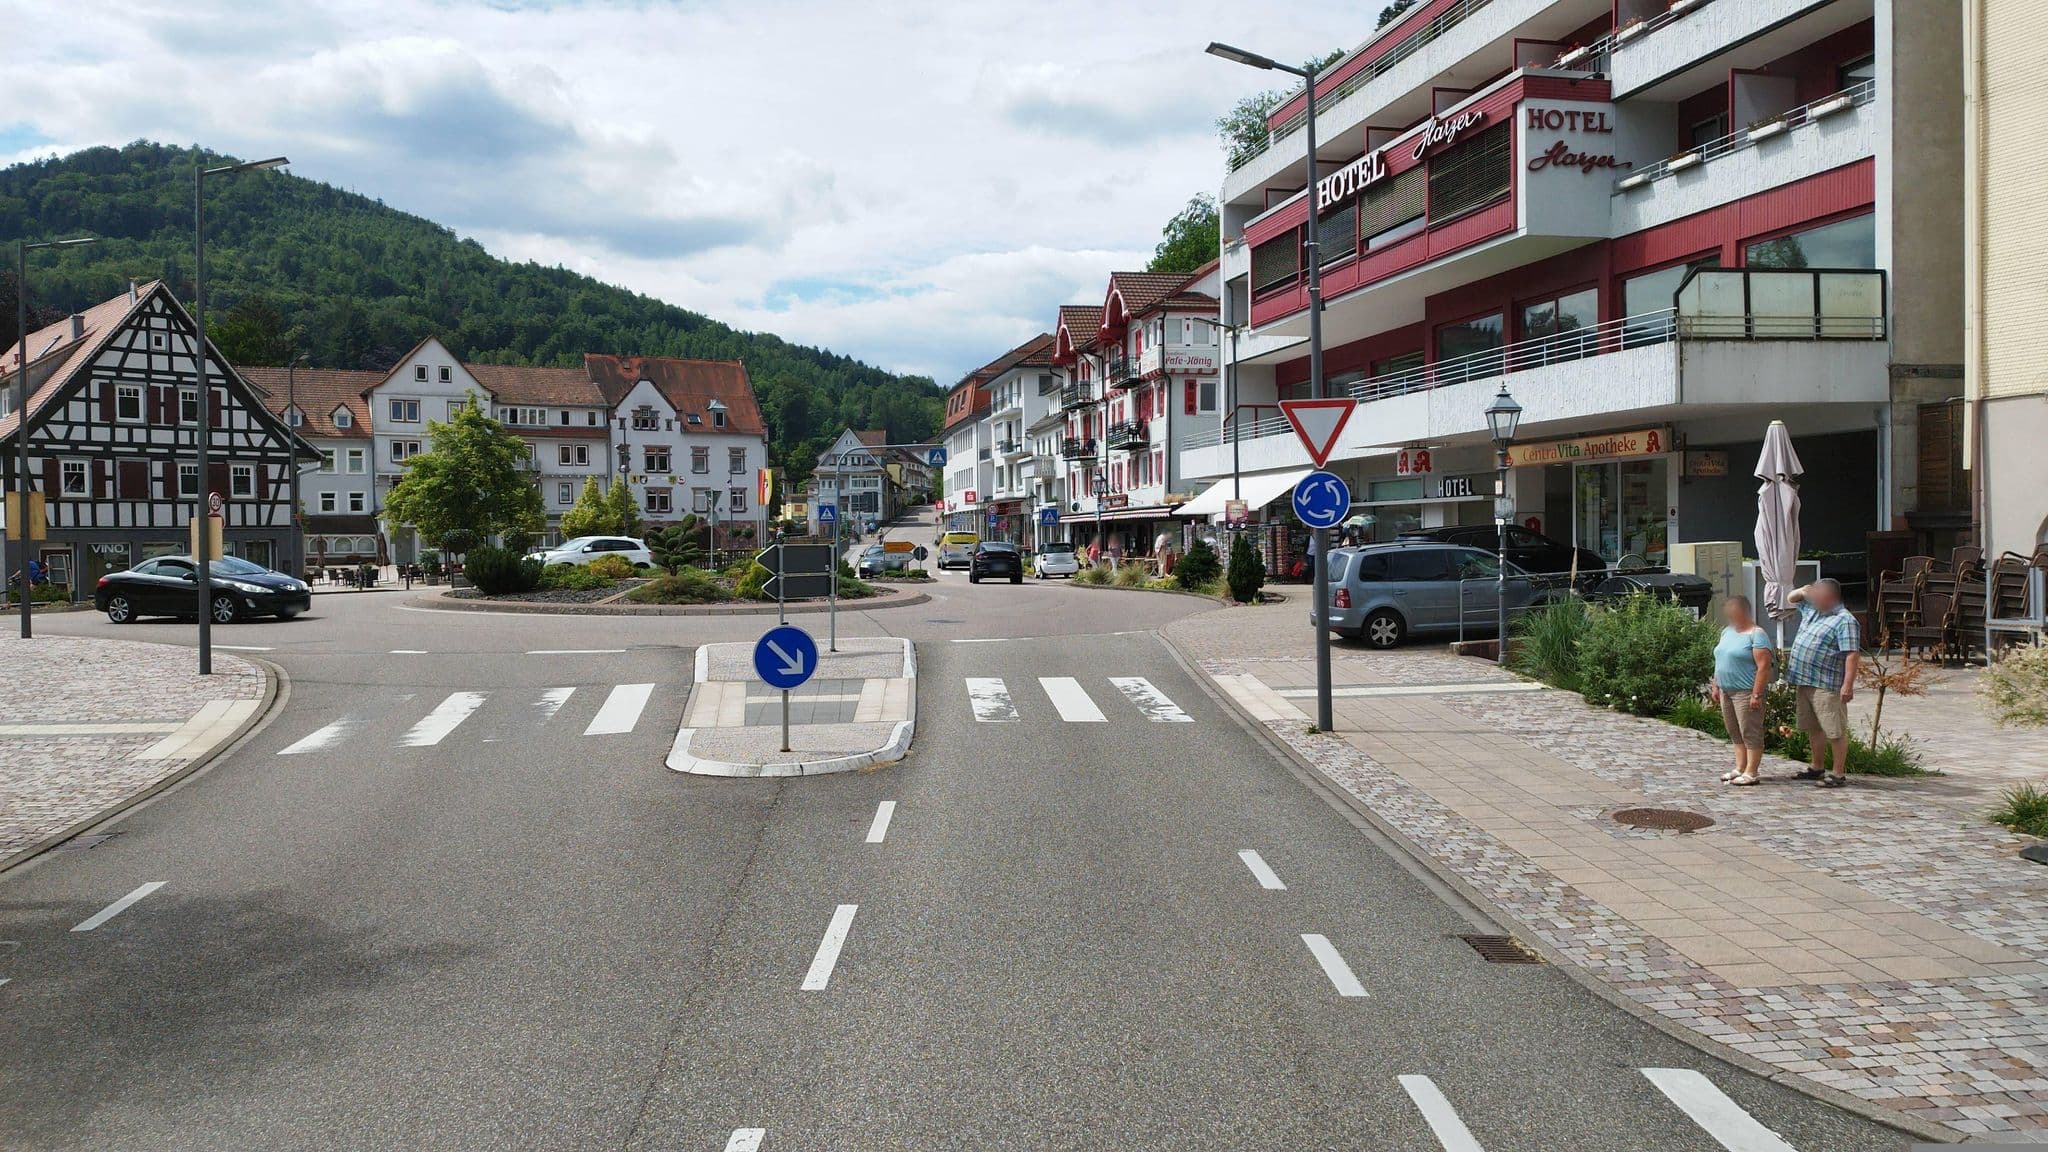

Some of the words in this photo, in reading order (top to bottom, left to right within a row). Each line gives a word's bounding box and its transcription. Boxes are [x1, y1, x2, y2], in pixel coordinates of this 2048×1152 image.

[1528, 108, 1613, 133] HOTEL
[1412, 111, 1484, 160] Harzer
[1527, 140, 1632, 173] Harzer
[1317, 150, 1385, 209] HOTEL
[1523, 443, 1580, 462] CentraVita
[1584, 436, 1637, 459] Apotheke
[1438, 478, 1472, 497] HOTEL
[212, 497, 219, 507] 30
[91, 544, 124, 553] VINO
